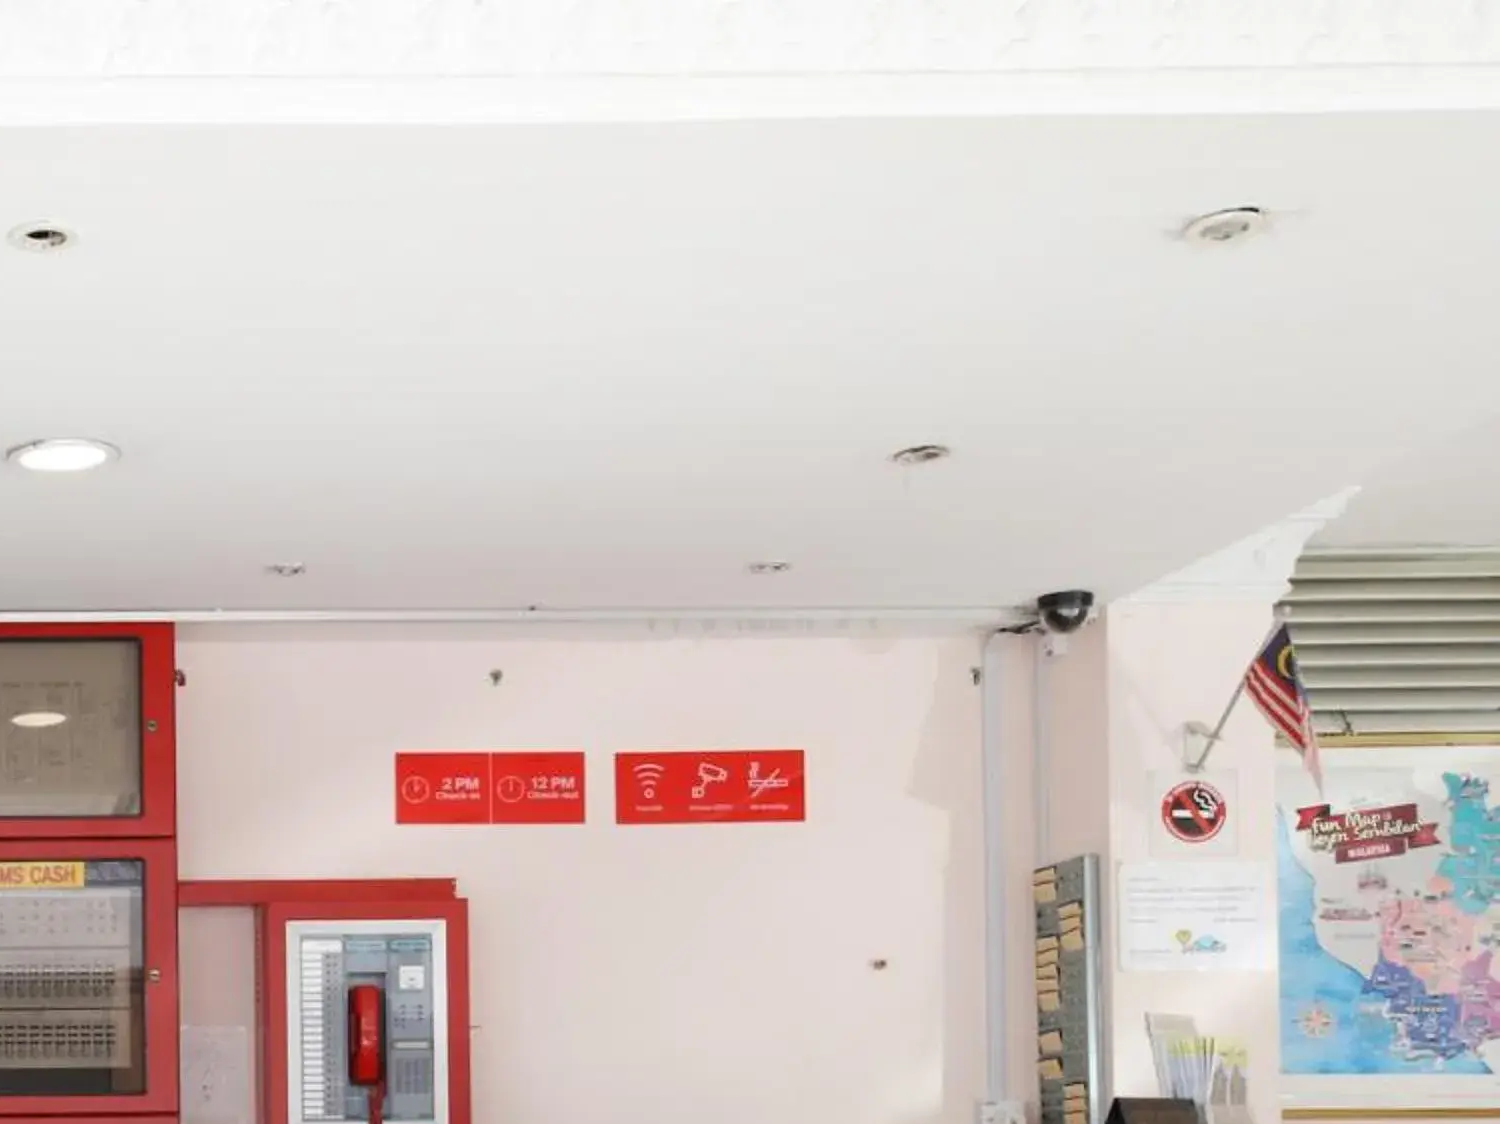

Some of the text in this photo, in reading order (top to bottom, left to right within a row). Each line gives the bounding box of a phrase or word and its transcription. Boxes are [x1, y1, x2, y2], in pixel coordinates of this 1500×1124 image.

[441, 777, 480, 790] 2 PM
[532, 776, 576, 790] 12 PM
[1311, 817, 1342, 834] Fun
[1345, 811, 1382, 830] Map
[30, 864, 76, 883] CASH
